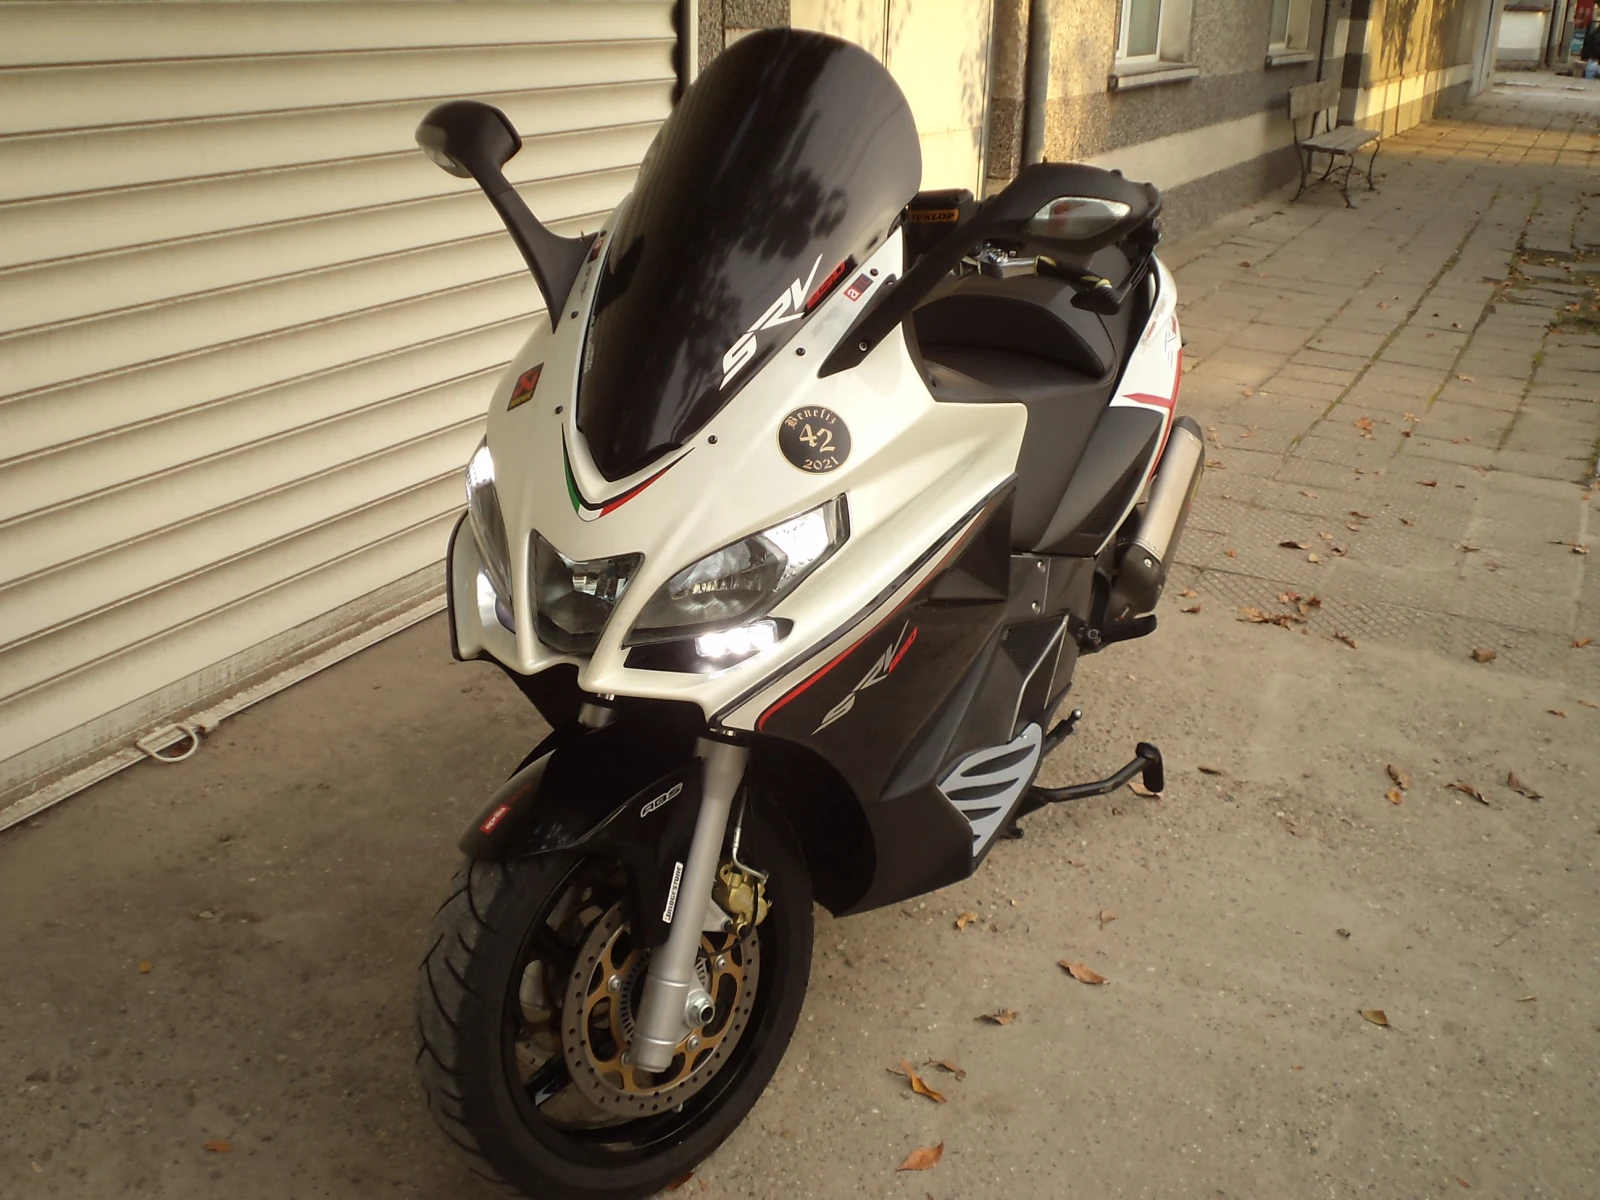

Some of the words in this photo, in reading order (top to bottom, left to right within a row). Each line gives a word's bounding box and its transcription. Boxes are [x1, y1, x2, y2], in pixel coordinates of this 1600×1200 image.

[719, 253, 824, 391] SRV
[799, 423, 836, 453] 42
[803, 456, 839, 470] 2021
[810, 619, 909, 736] SRV
[664, 864, 682, 921] BRIDGESTONE
